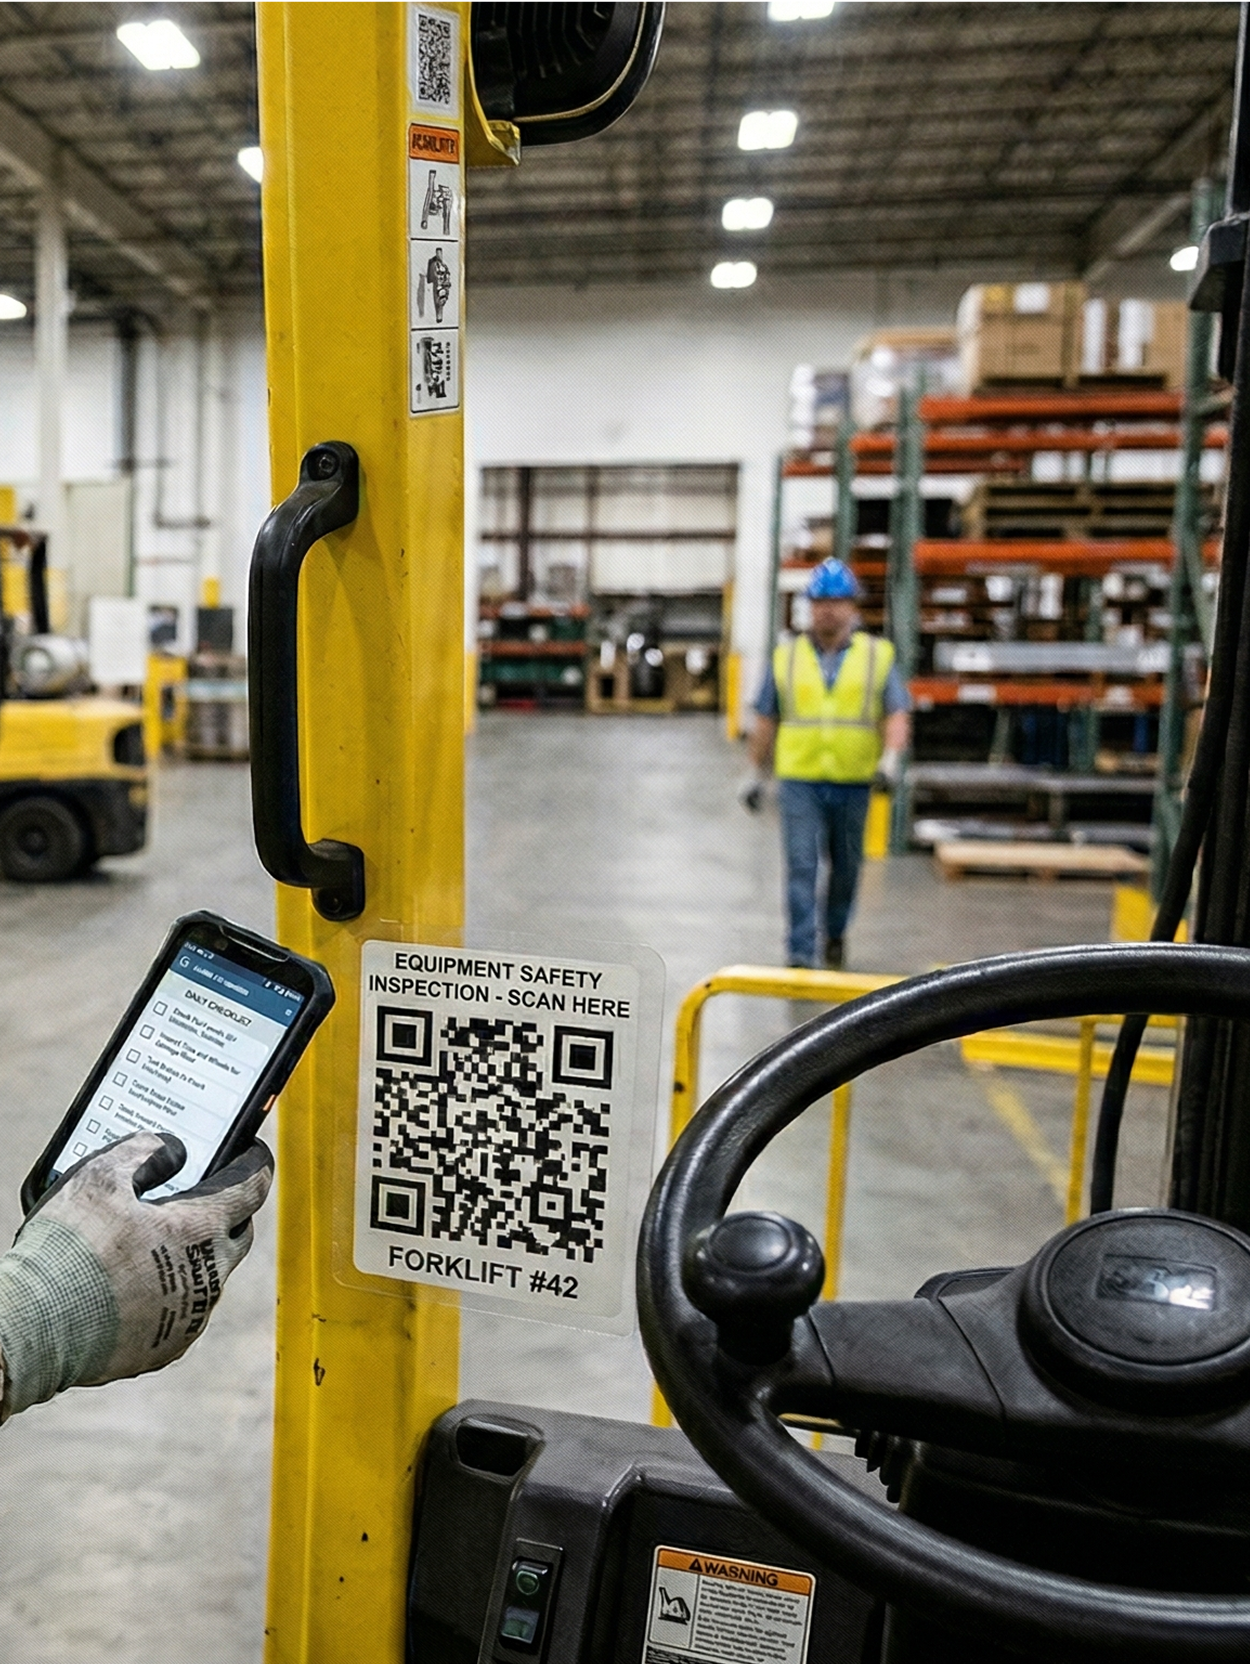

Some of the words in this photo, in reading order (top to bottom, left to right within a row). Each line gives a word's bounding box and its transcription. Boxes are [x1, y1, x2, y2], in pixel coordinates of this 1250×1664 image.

[396, 953, 514, 980] EQUIPMENT
[521, 964, 603, 989] SAFETY
[369, 975, 489, 1003] INSPECTION
[507, 988, 566, 1011] SCAN
[573, 996, 630, 1019] HERE
[389, 1246, 522, 1289] FORKLIFT
[529, 1270, 579, 1300] #42
